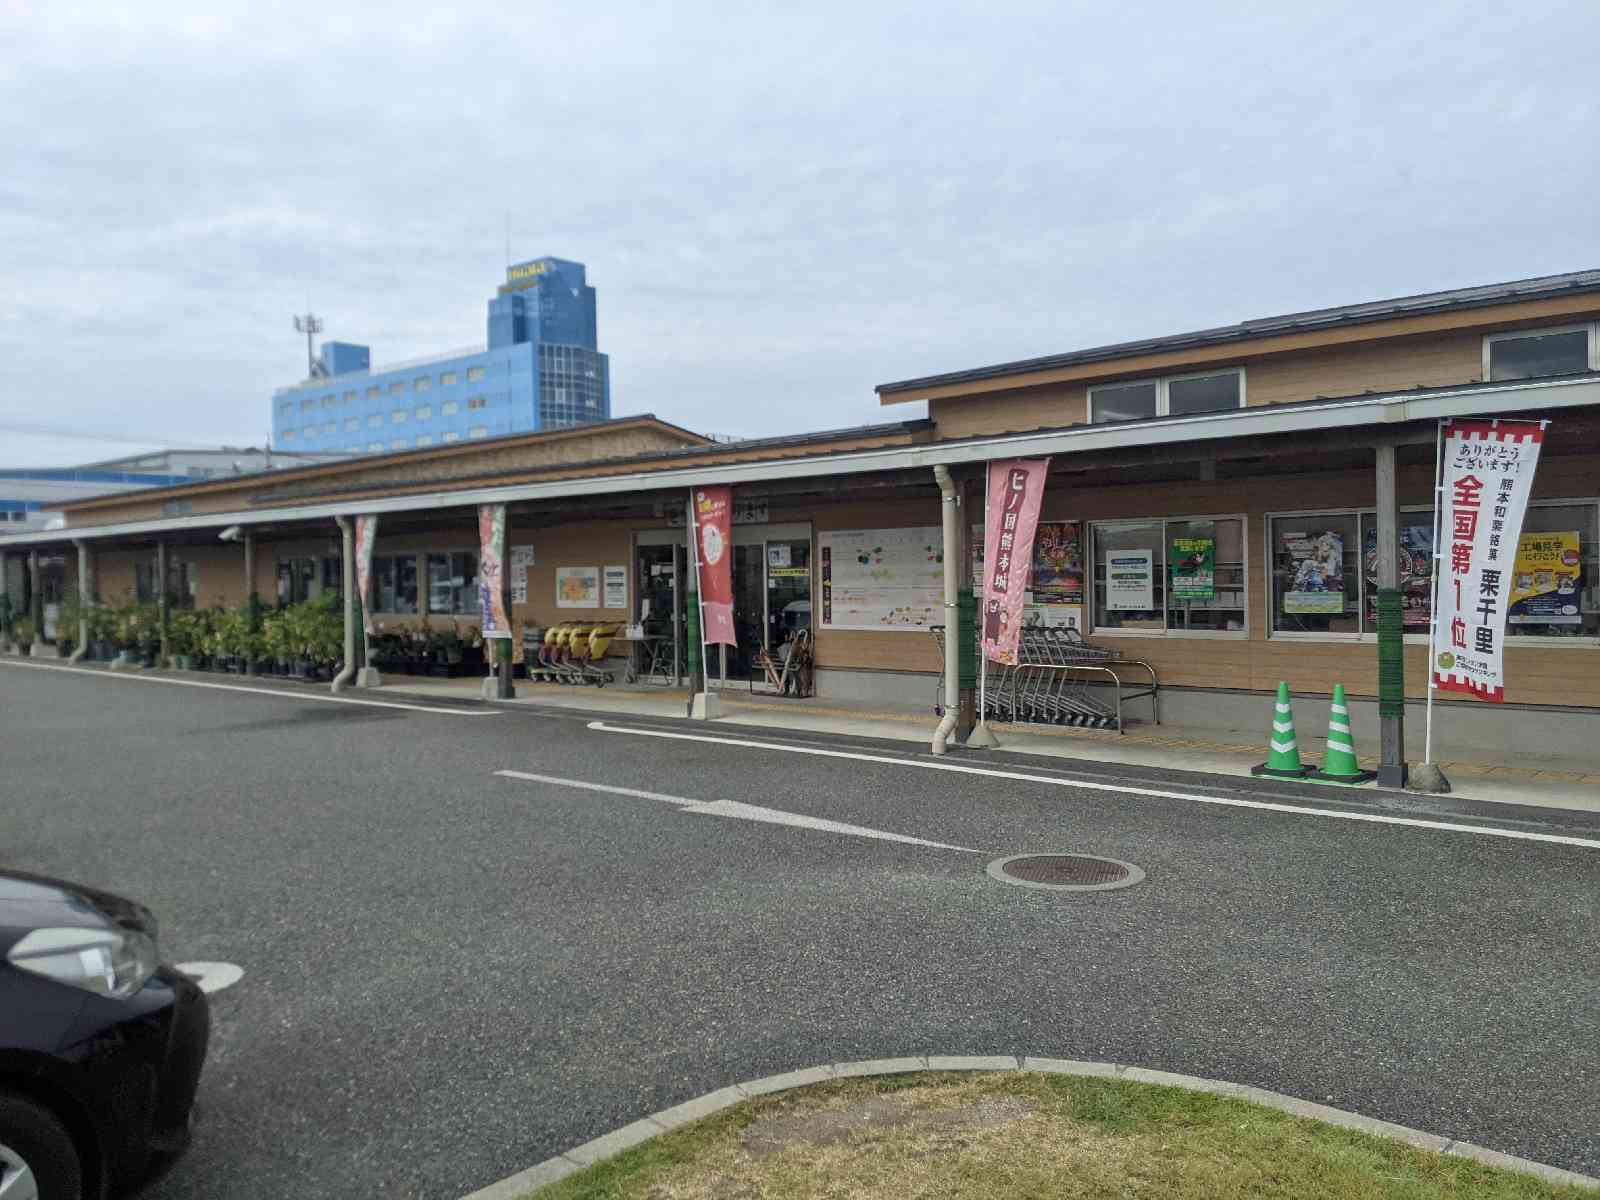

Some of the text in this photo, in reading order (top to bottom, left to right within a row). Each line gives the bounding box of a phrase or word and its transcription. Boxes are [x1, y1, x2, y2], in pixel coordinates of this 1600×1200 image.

[1460, 444, 1519, 460] ありがとう
[995, 472, 1024, 590] ヒノ国熊本城
[1451, 474, 1484, 649] 全国第1位
[1475, 568, 1502, 655] 栗千里
